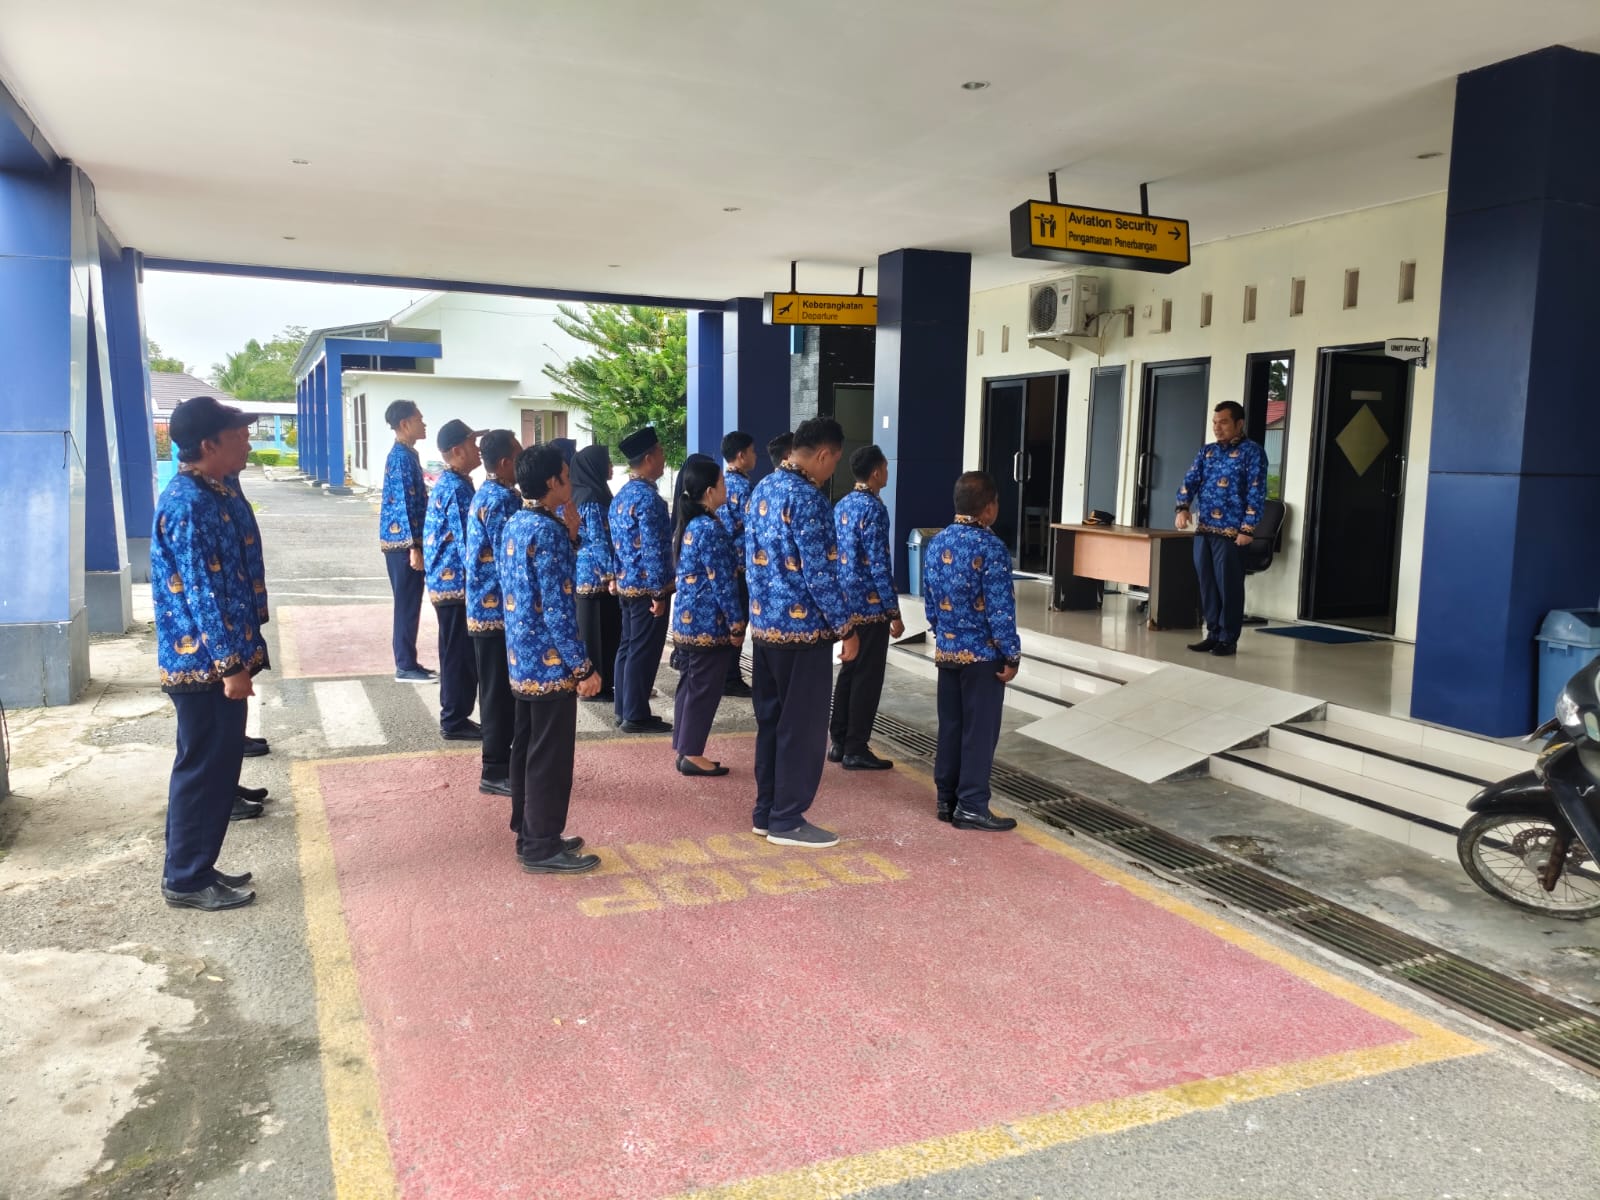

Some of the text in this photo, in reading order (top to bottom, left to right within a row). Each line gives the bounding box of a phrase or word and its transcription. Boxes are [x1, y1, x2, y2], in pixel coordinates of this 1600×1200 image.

[1068, 211, 1158, 235] Aviation Security
[1068, 231, 1158, 252] Pengamanan Penerbangan
[802, 300, 863, 311] Keberangkatan
[802, 311, 838, 321] Departure
[1391, 344, 1403, 352] UNIT
[576, 852, 911, 917] DROP
